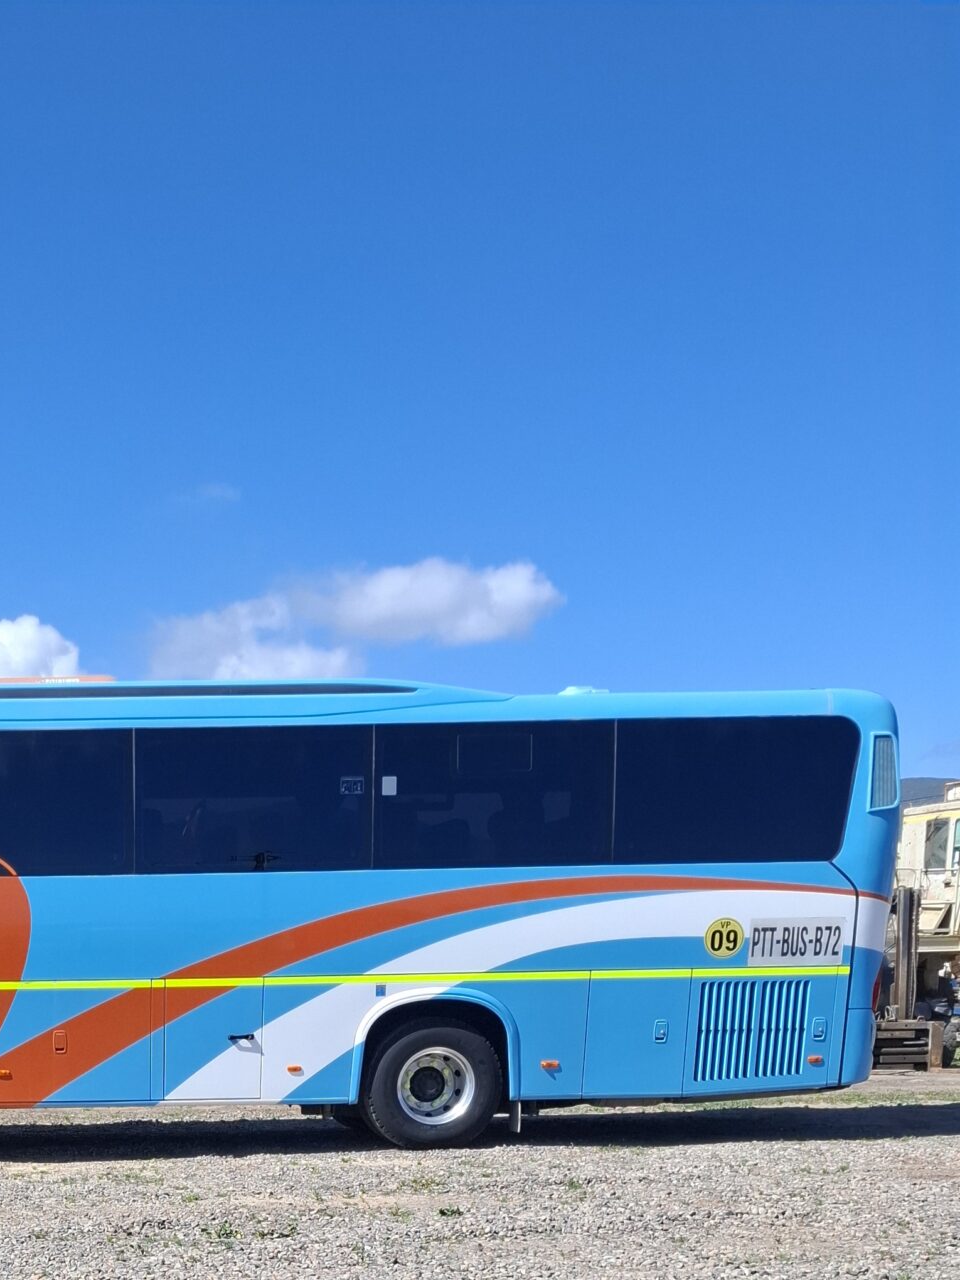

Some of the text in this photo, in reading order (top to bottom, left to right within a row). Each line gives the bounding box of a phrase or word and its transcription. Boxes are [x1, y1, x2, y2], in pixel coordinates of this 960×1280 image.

[720, 921, 731, 929] VP
[710, 929, 739, 952] 09
[751, 926, 842, 958] PTT-BUS-B72
